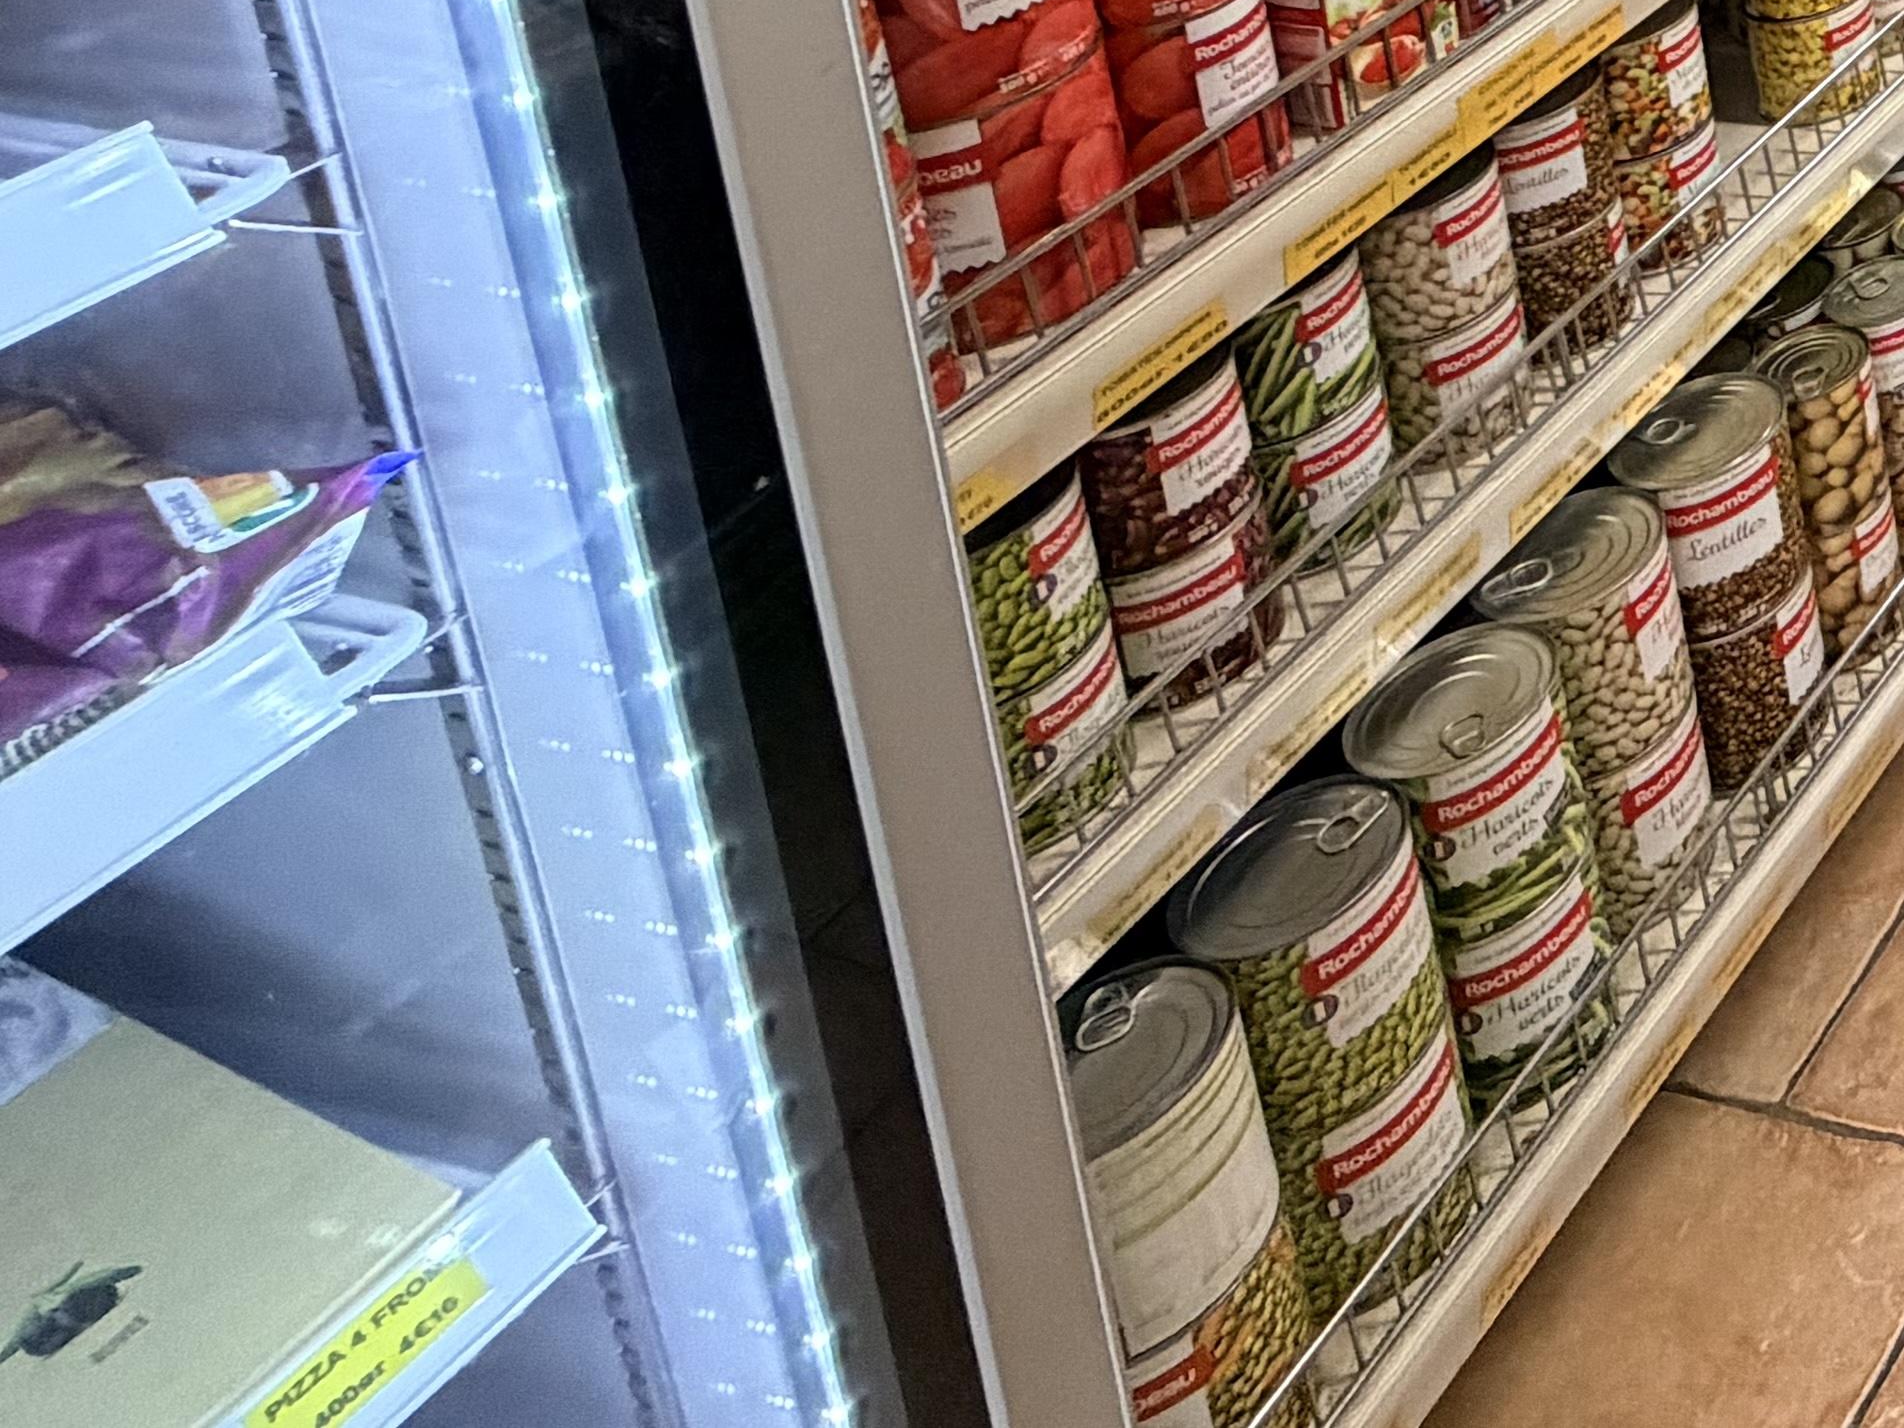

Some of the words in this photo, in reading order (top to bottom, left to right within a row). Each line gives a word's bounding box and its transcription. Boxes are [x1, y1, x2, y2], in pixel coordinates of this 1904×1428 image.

[1665, 469, 1774, 531] Rochambeau
[1688, 514, 1768, 563] Lentilles
[1435, 729, 1558, 824] Rochambeau
[1458, 779, 1556, 850] Haricots
[1462, 902, 1591, 998] Rochambeau
[263, 1349, 348, 1425] PIZZA
